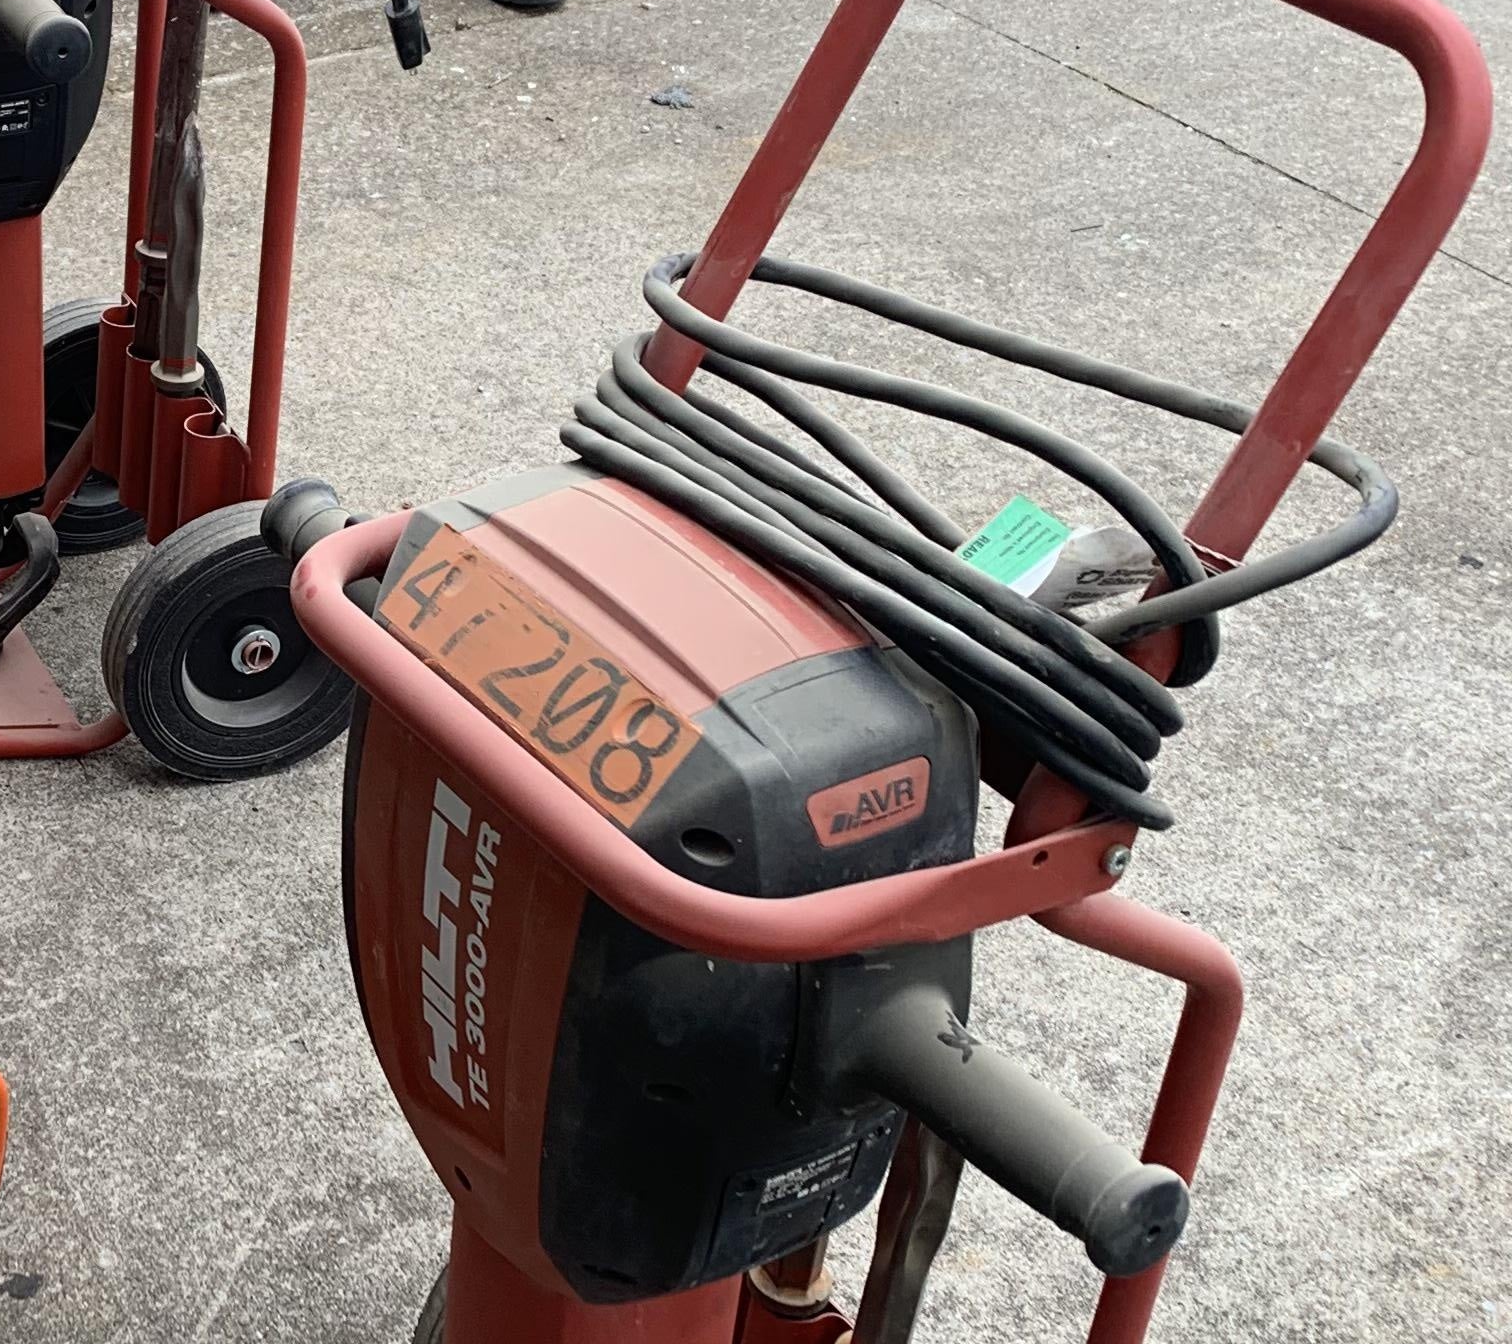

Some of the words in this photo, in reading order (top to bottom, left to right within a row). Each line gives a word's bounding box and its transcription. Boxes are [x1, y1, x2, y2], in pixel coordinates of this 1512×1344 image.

[856, 775, 915, 816] AVR
[421, 777, 472, 1110] HILTI
[464, 821, 502, 1056] 3000-AVR
[466, 1054, 490, 1111] TE
